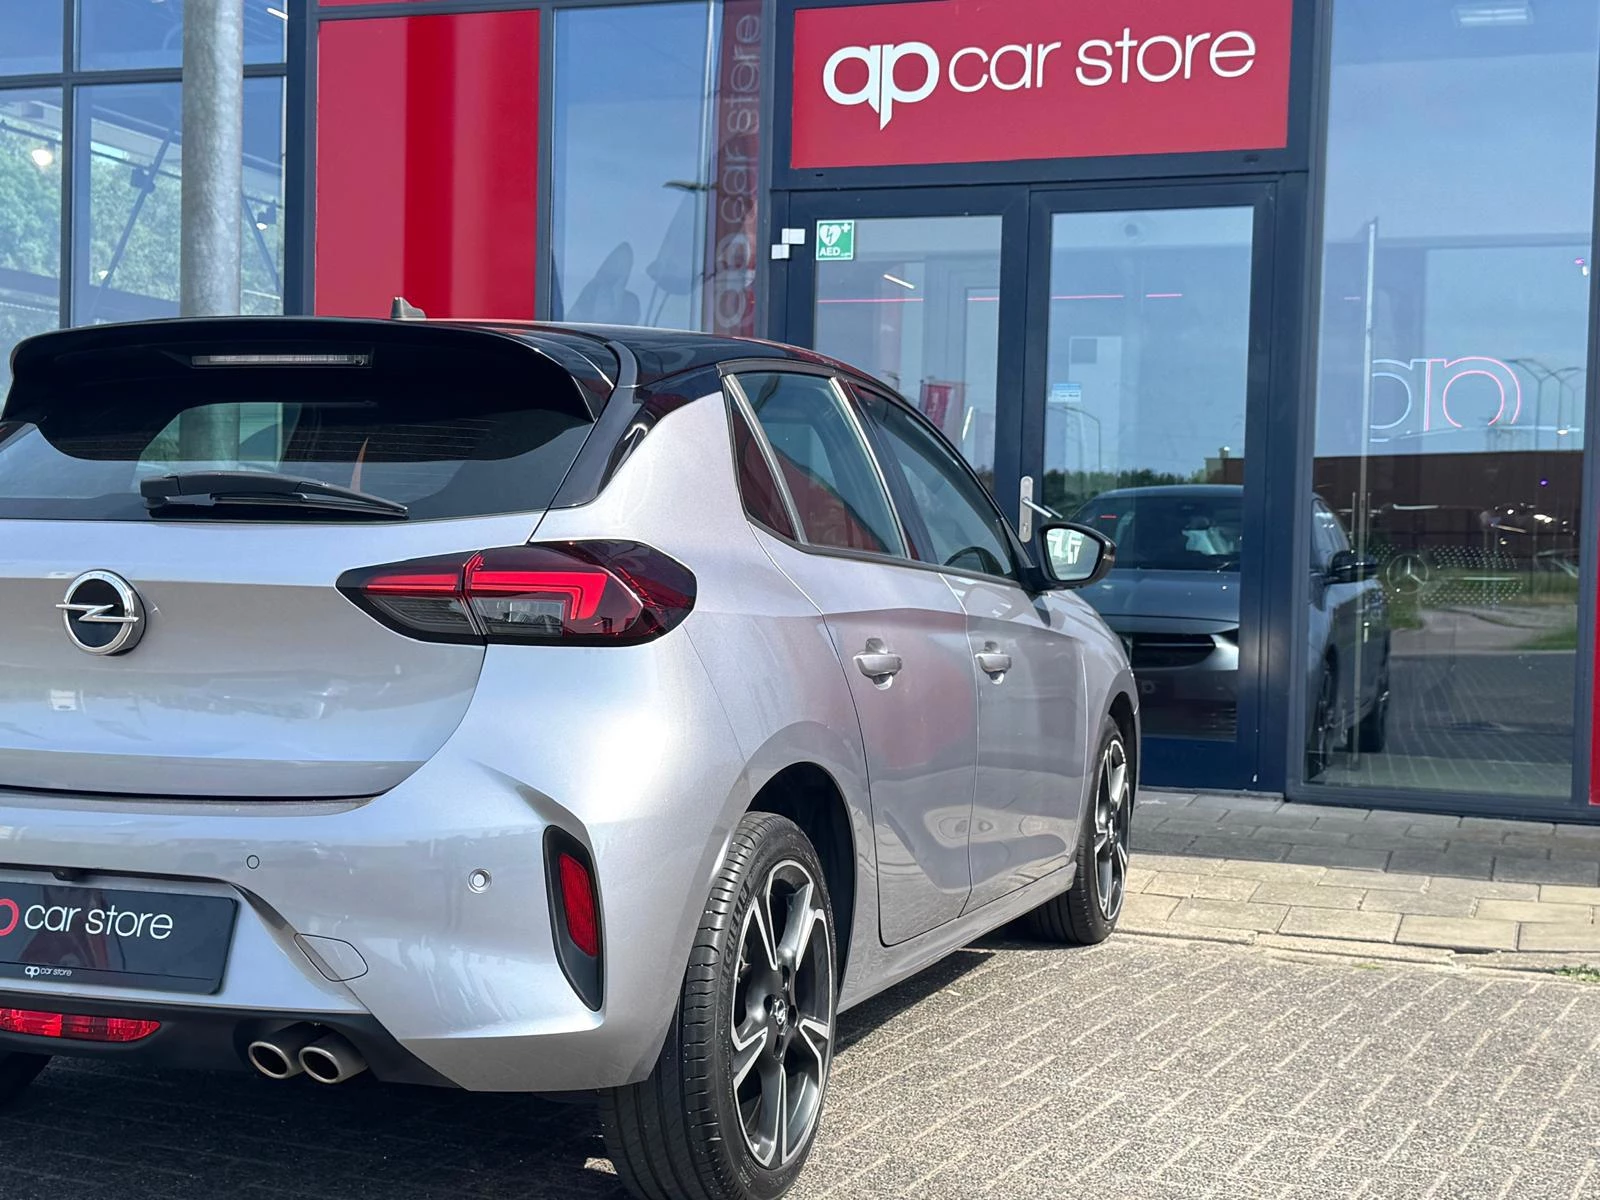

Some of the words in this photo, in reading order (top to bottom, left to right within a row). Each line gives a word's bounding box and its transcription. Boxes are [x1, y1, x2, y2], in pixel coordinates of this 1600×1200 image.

[726, 15, 760, 134] store
[948, 41, 1061, 93] car
[1075, 28, 1256, 87] store
[819, 246, 841, 257] AED
[23, 904, 82, 933] car
[84, 904, 174, 940] store
[40, 967, 53, 975] car
[53, 968, 73, 977] store
